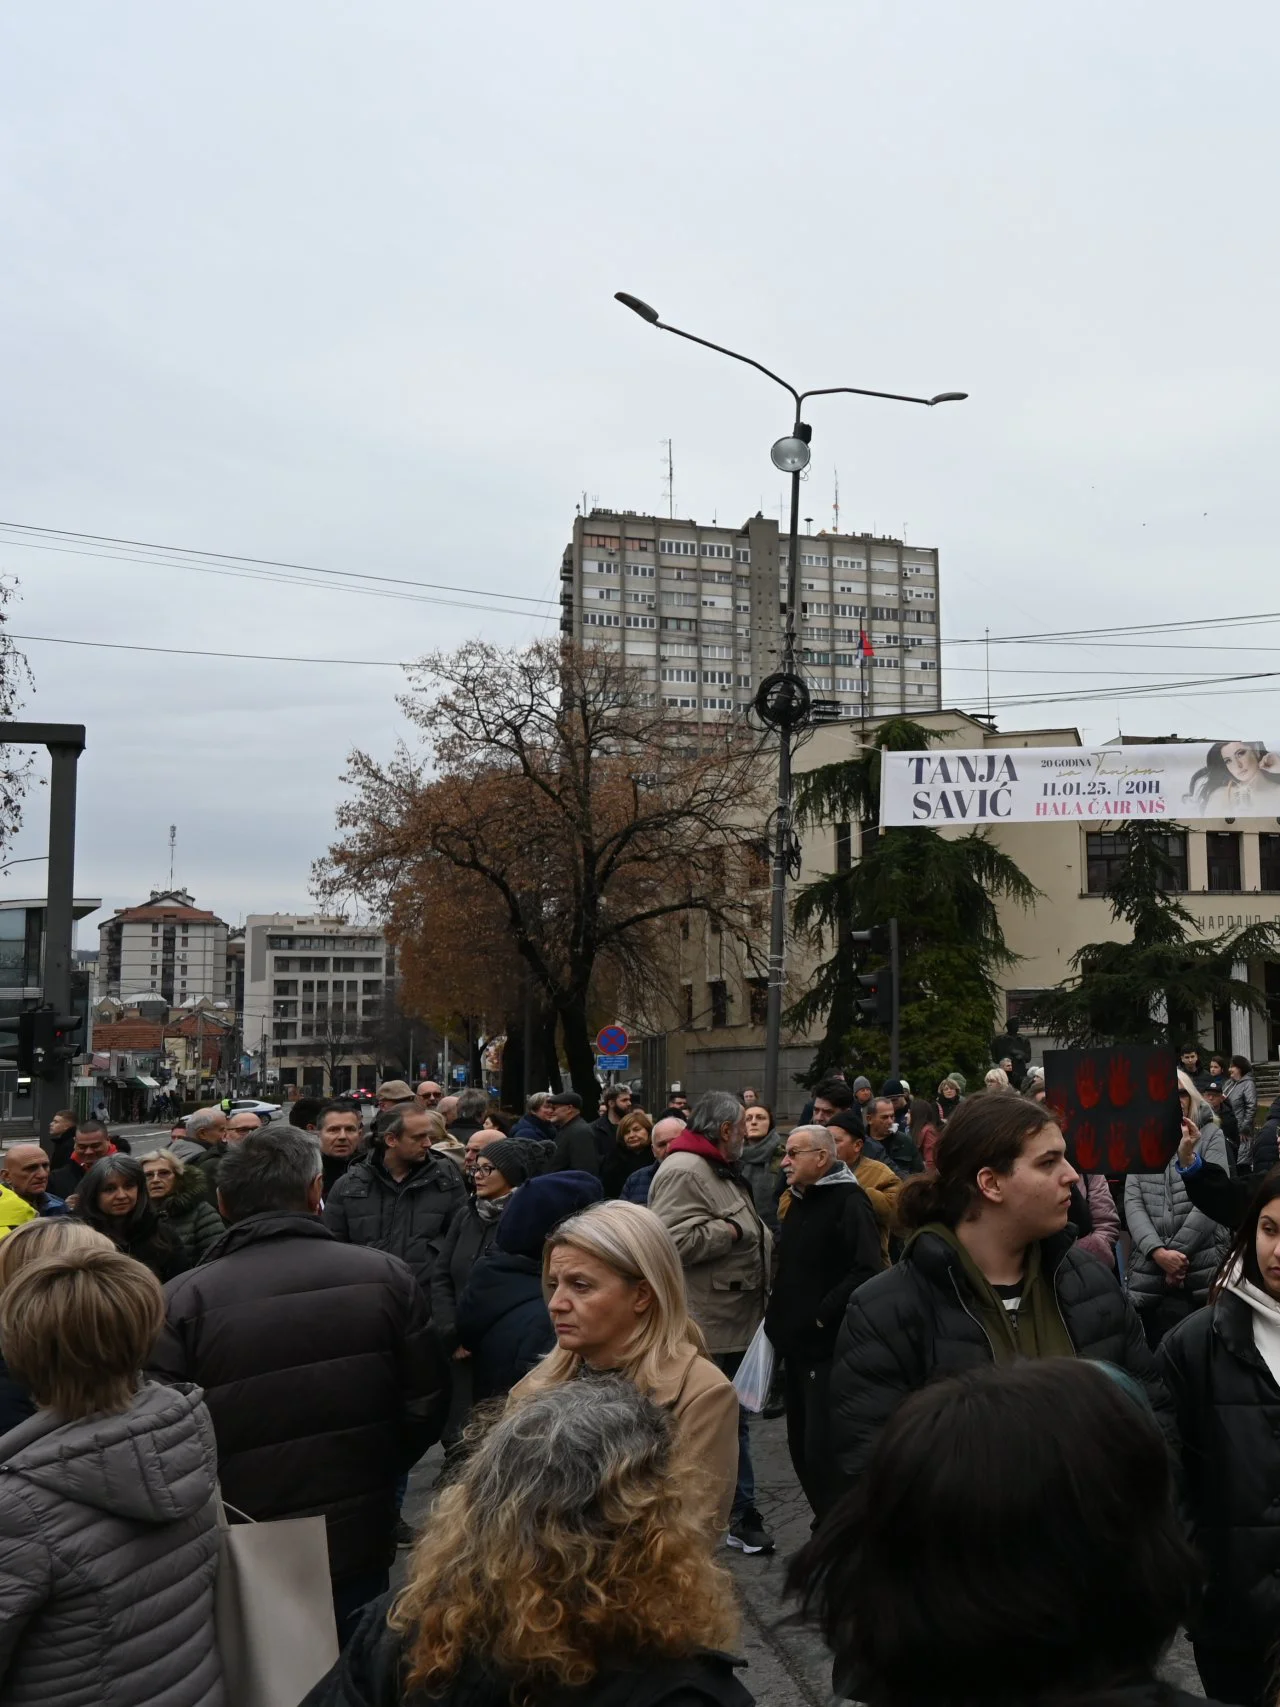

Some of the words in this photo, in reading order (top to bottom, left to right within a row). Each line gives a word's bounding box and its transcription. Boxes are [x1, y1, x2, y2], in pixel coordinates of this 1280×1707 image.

[908, 754, 1019, 785] TANJA
[1040, 759, 1053, 768] 20
[1054, 758, 1092, 768] GODINA
[1041, 781, 1112, 796] 11.01.25.
[1125, 780, 1161, 795] 20H
[911, 781, 1012, 820] SAVIĆ
[1035, 801, 1083, 816] HALA
[1087, 797, 1132, 815] ČAIR
[1137, 796, 1166, 814] NIŠ
